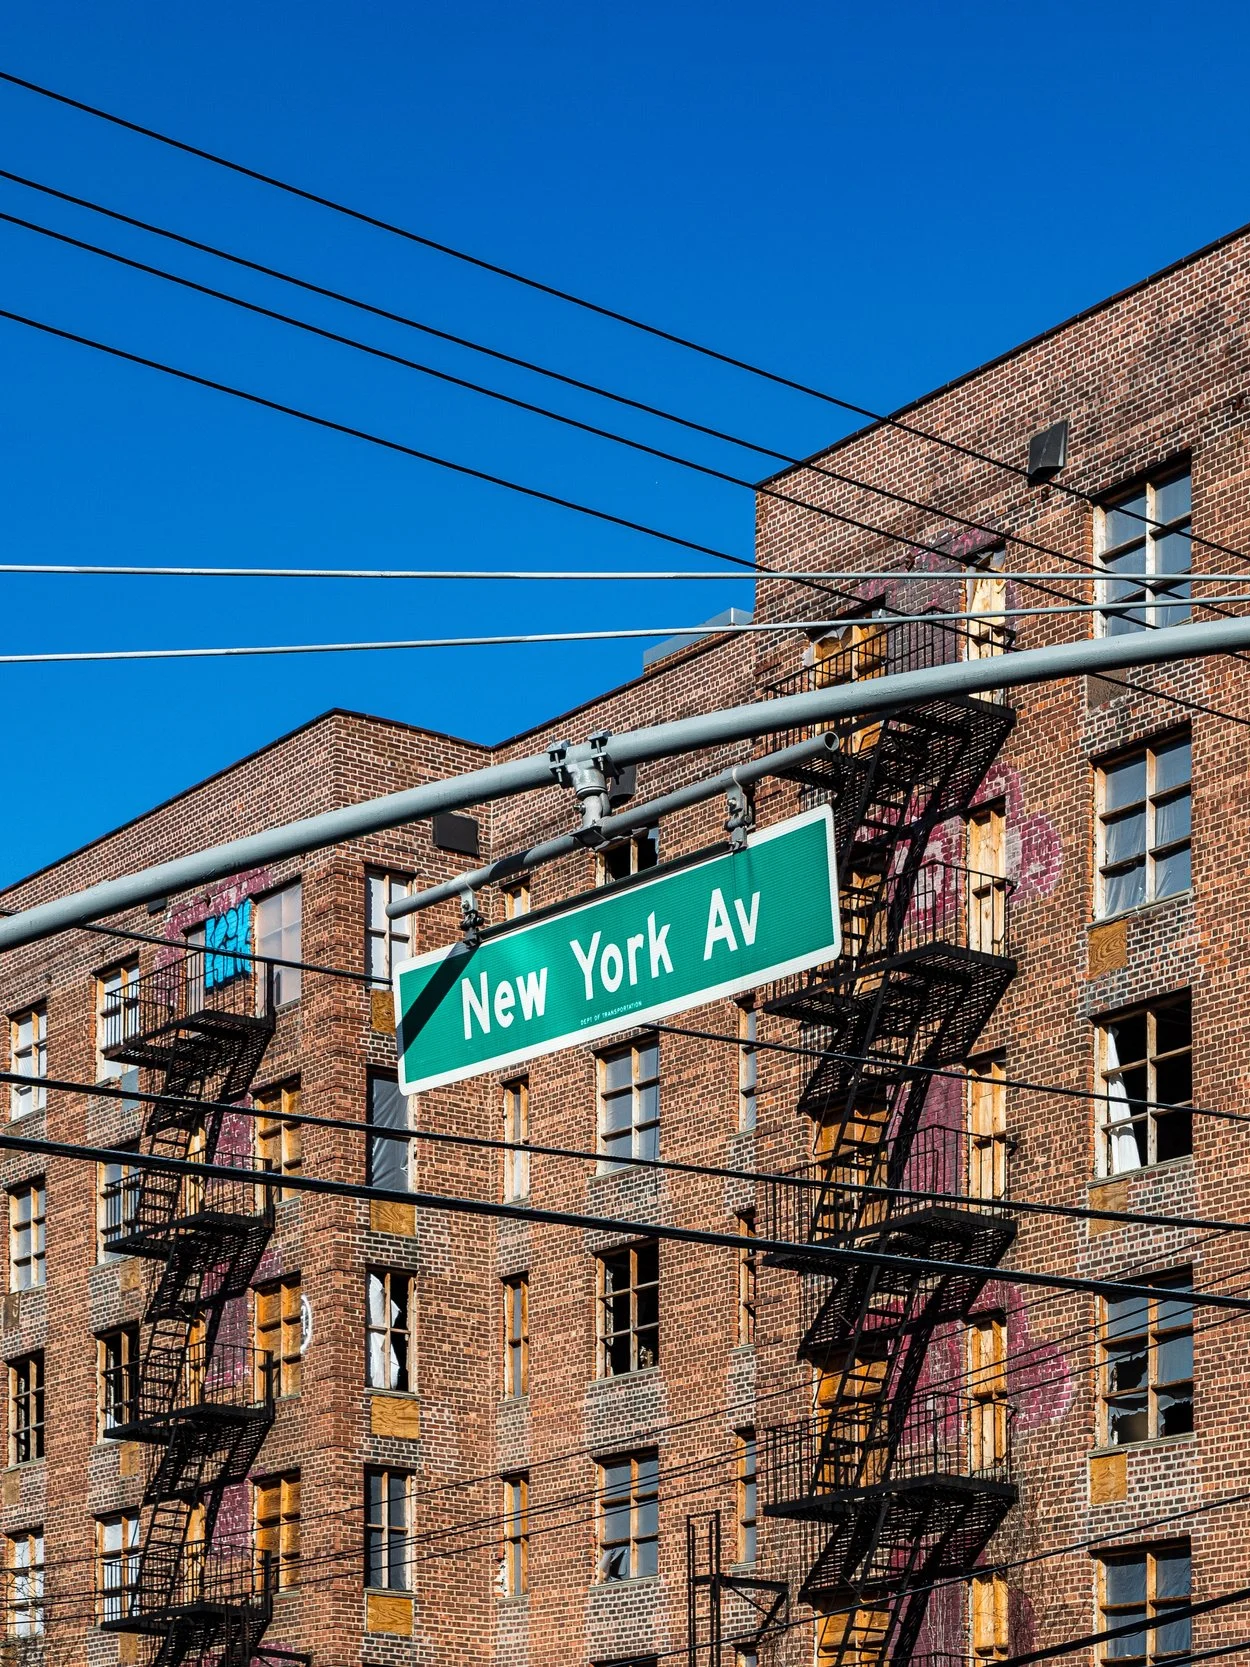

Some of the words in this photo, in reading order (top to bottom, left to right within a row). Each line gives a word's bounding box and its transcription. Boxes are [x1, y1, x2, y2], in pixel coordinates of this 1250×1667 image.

[461, 967, 548, 1040] New
[569, 911, 674, 1001] York
[703, 887, 761, 961] Av
[580, 1016, 593, 1026] DEPT
[594, 1013, 601, 1022] OF
[601, 1000, 643, 1019] TRANSPORTATION
